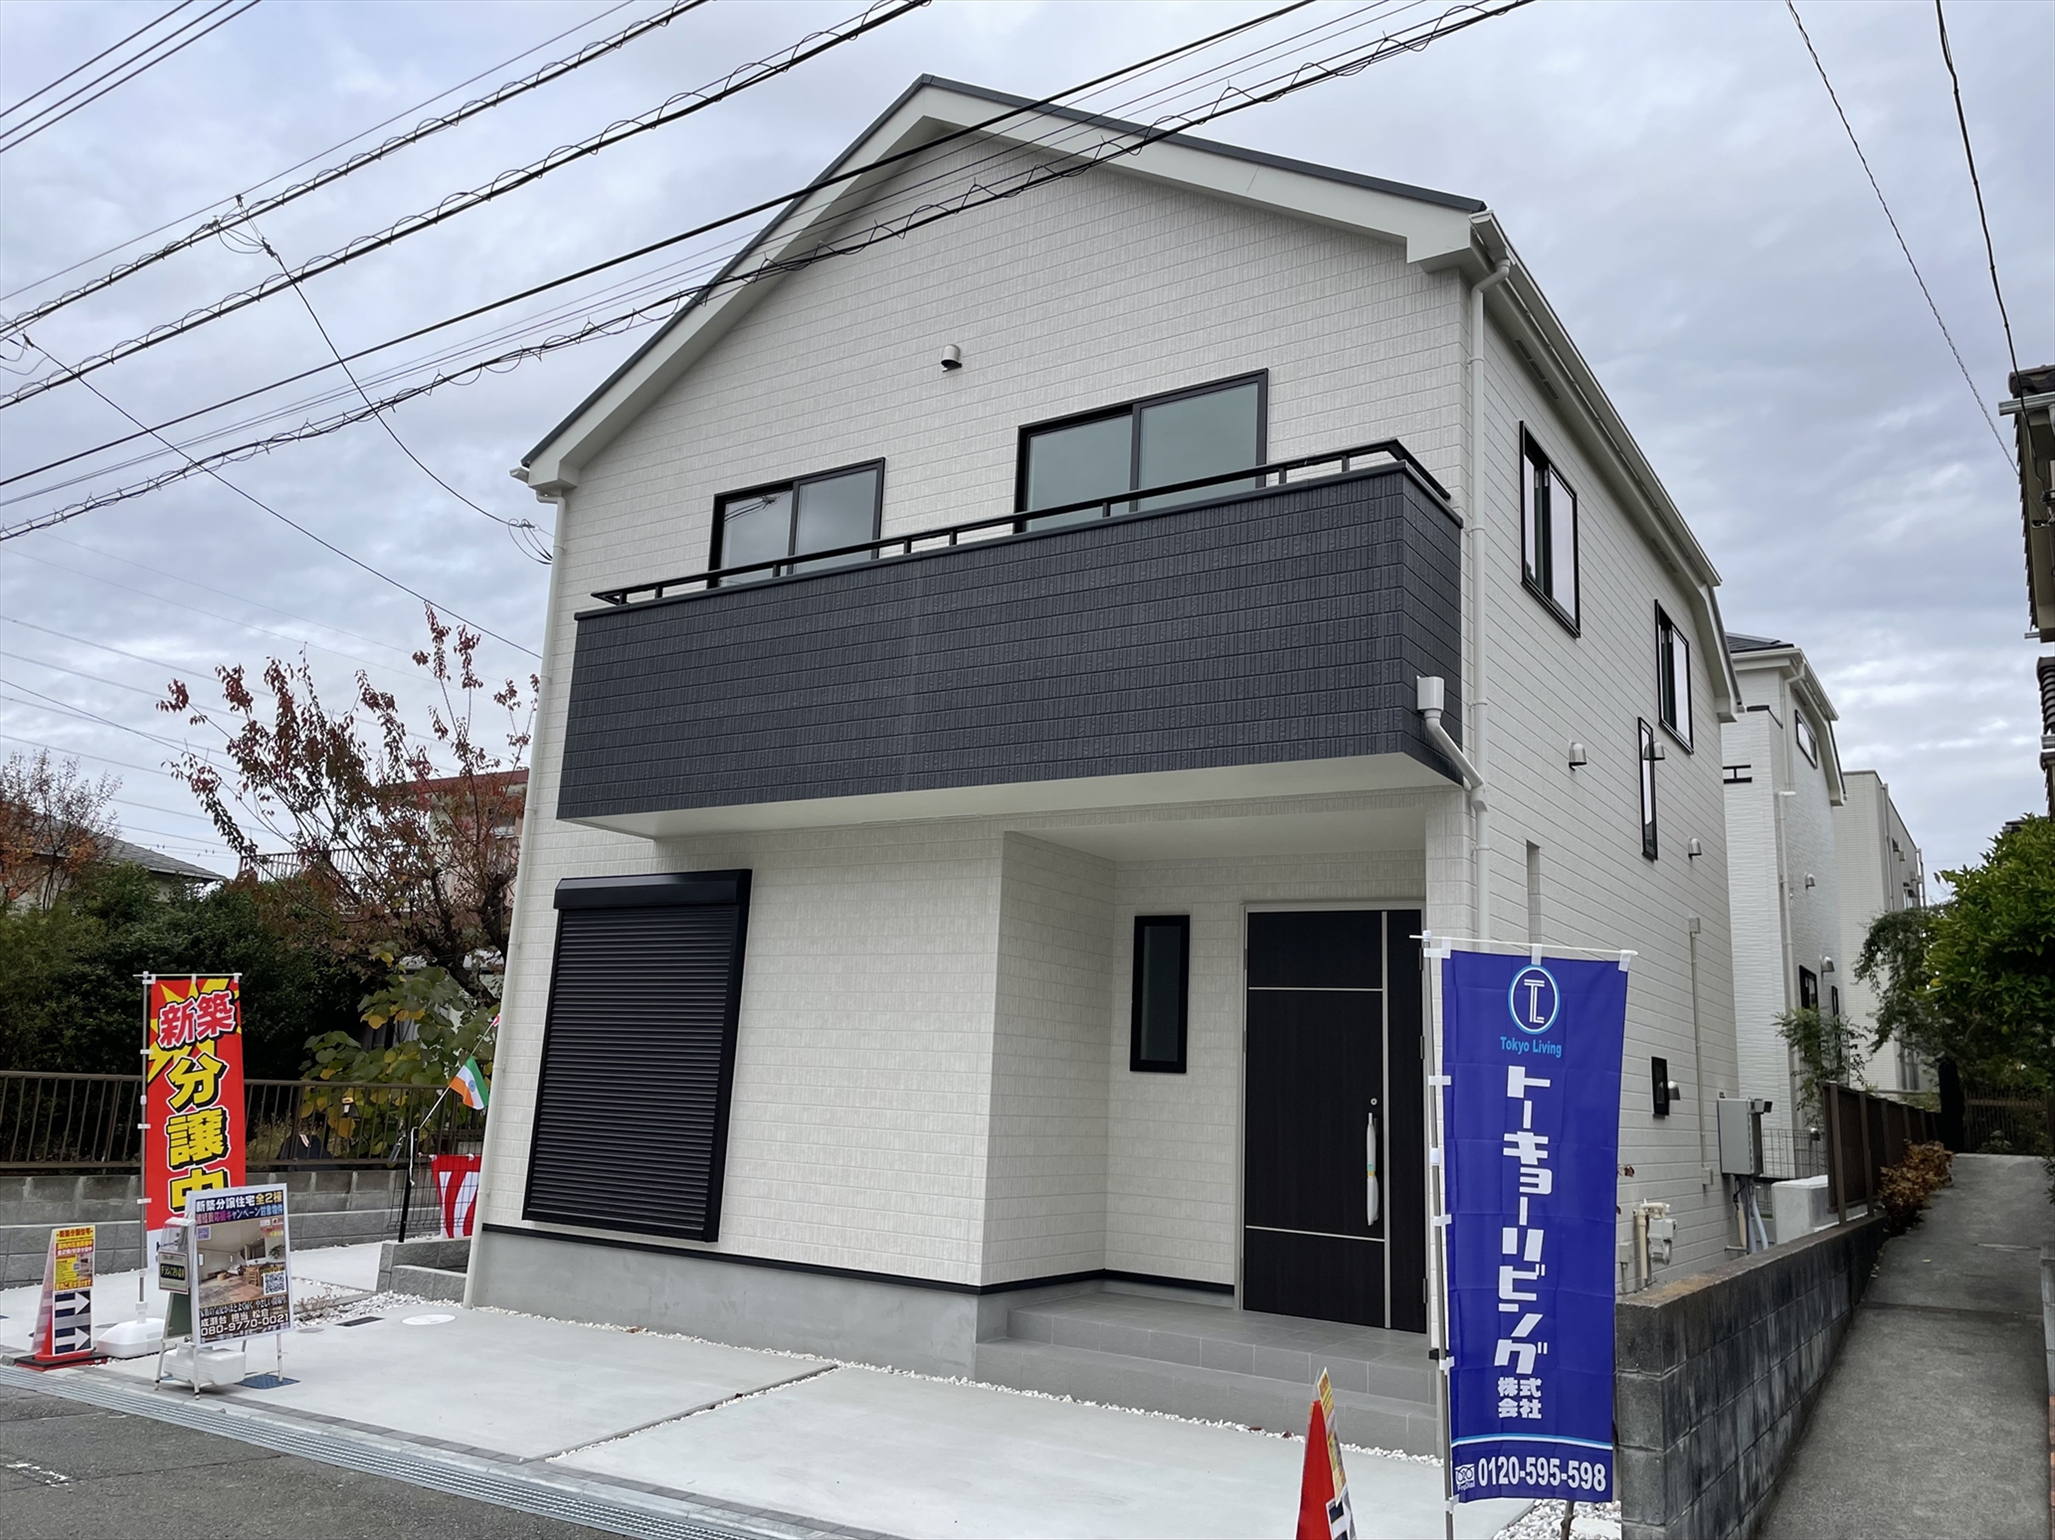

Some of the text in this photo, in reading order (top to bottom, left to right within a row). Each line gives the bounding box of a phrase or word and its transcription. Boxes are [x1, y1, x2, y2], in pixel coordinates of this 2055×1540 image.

[158, 991, 238, 1048] 新築
[1500, 1036, 1562, 1058] Tokyo Living
[201, 1313, 289, 1336] 080-9770-0021
[1478, 1456, 1607, 1492] 0120-595-598
